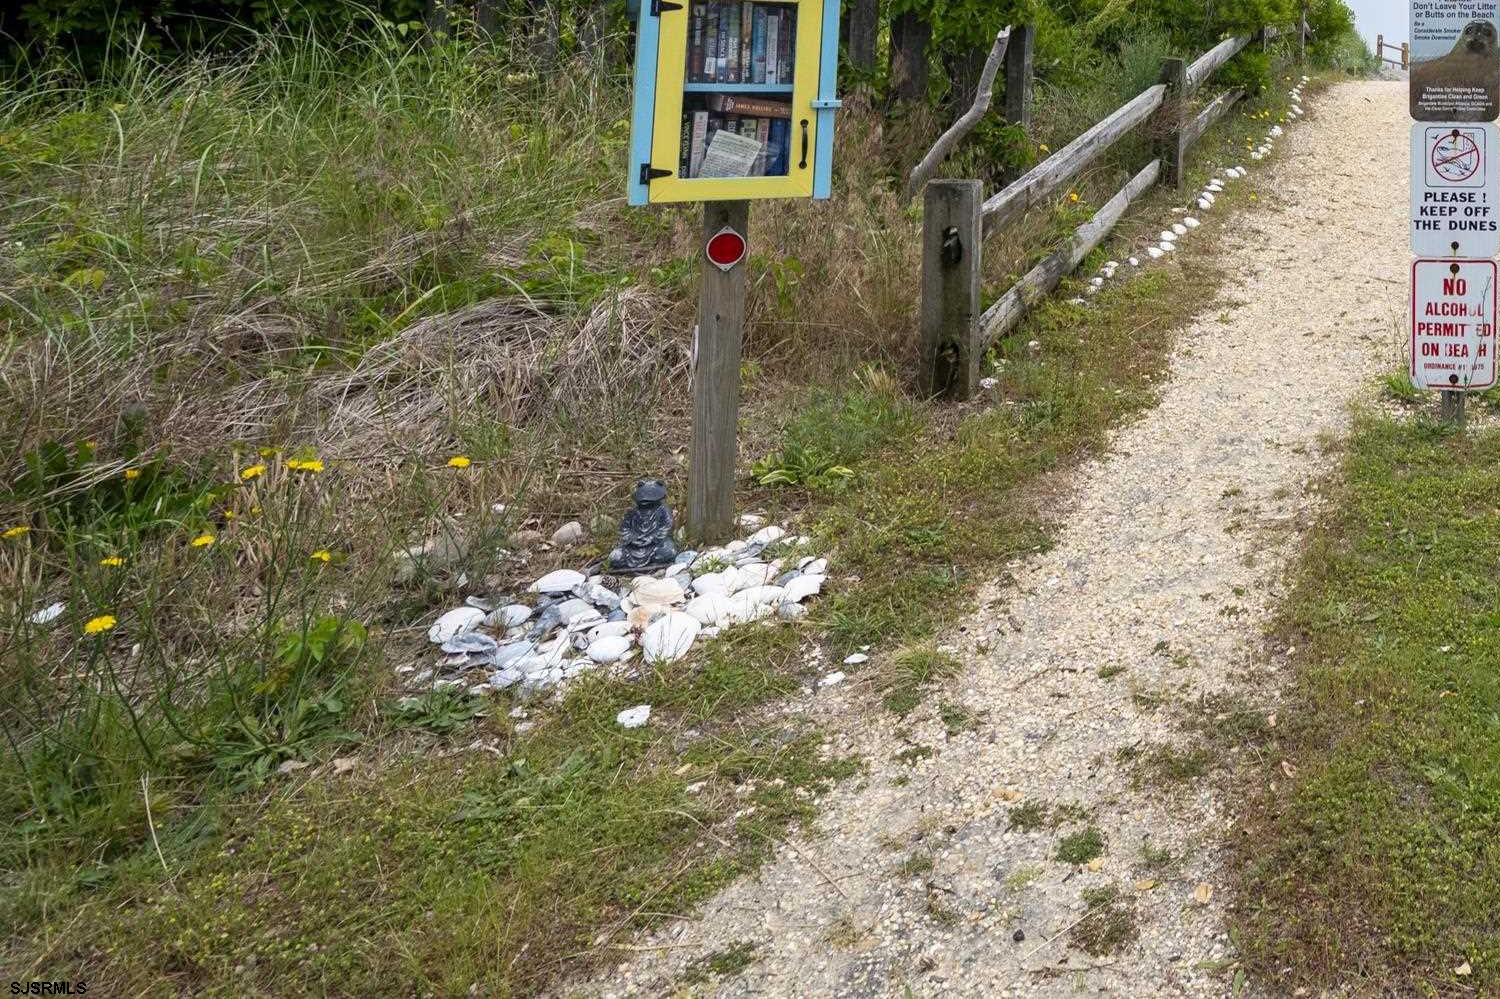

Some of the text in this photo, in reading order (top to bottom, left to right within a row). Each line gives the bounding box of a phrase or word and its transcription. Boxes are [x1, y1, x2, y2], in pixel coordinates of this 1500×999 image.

[1413, 2, 1496, 10] Don't Leave Your Litter
[1425, 10, 1444, 18] Butts
[1458, 10, 1469, 18] the
[1471, 10, 1494, 18] Beach
[1424, 192, 1476, 202] PLEASE
[1420, 206, 1490, 217] KEEP OFF
[1414, 220, 1497, 231] THE DUNES
[1443, 278, 1466, 296] NO
[1418, 322, 1491, 337] PERMITED
[1422, 342, 1487, 357] ON BEAH
